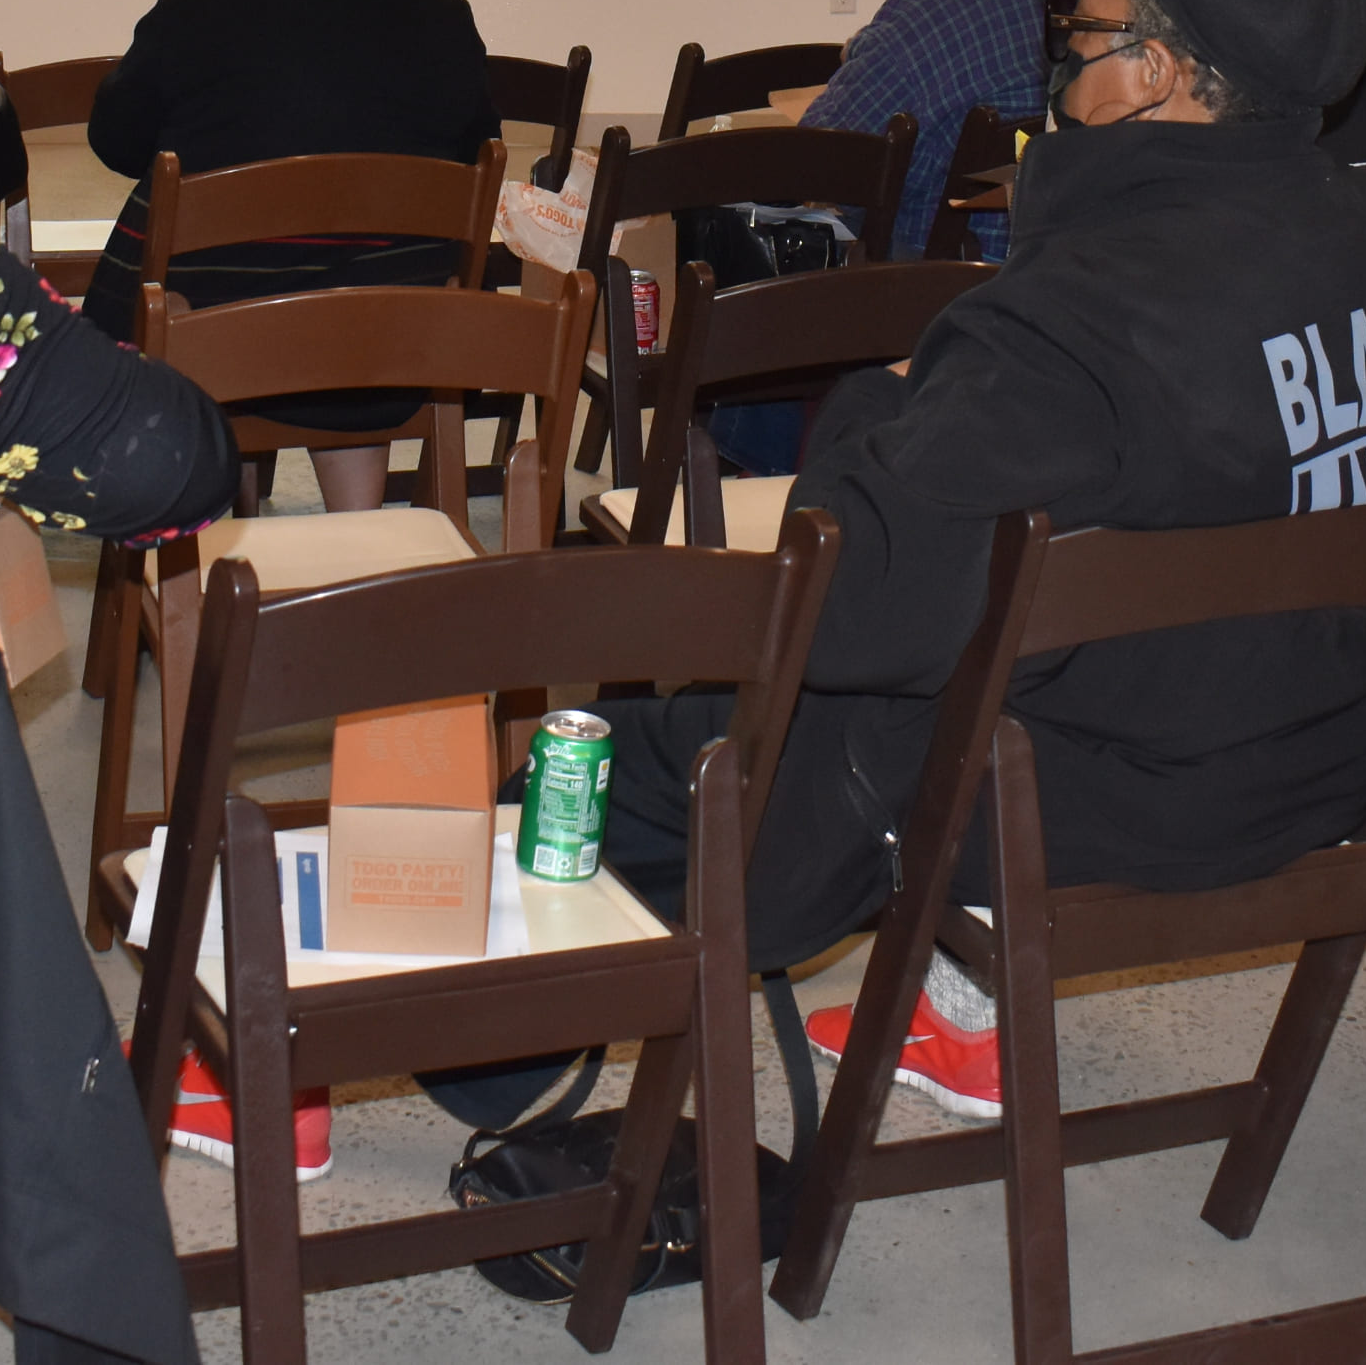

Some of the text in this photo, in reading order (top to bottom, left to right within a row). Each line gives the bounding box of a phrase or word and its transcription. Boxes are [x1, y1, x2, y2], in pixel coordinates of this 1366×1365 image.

[536, 204, 575, 229] TOGO'S
[352, 861, 464, 879] TOGO PARTY!
[352, 877, 402, 891] ORDER
